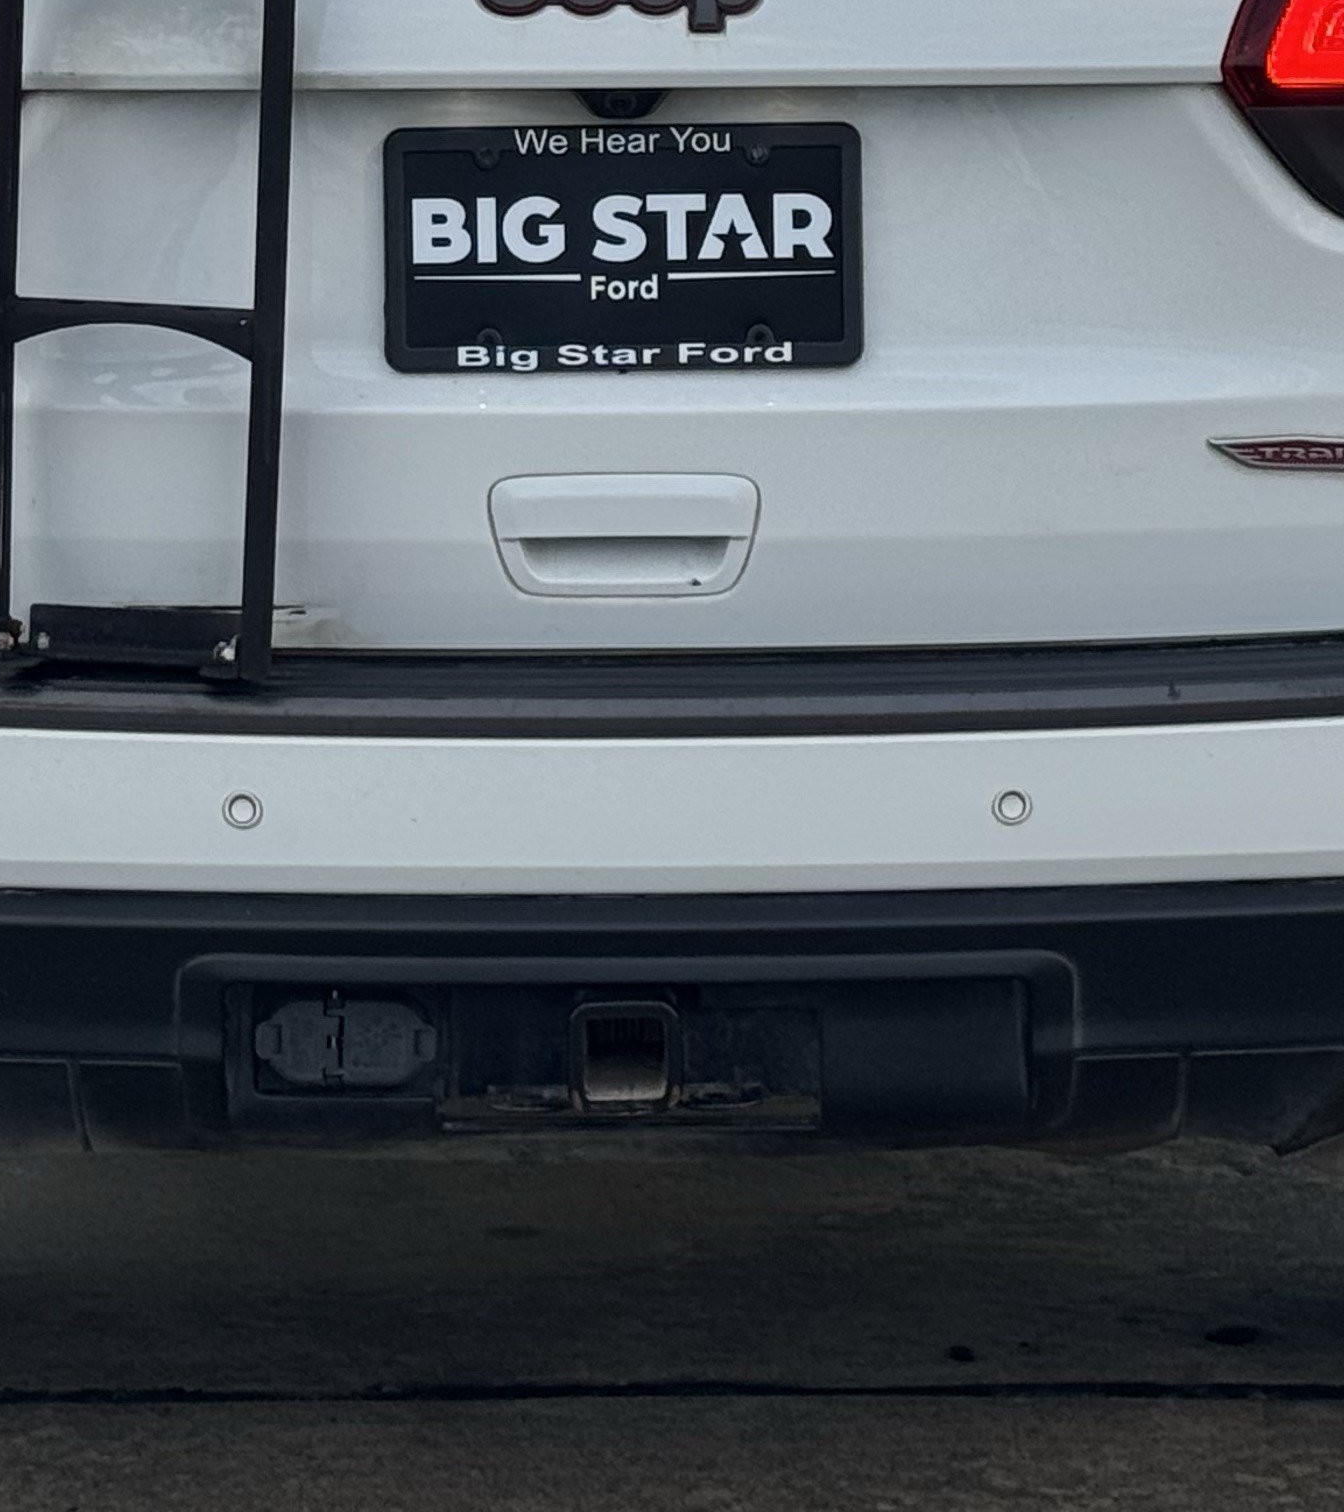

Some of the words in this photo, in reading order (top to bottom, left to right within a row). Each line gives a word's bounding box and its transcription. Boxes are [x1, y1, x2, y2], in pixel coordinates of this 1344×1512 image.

[514, 128, 569, 155] We
[581, 128, 660, 155] Hear
[670, 126, 732, 154] You
[411, 195, 567, 265] BIG
[591, 192, 835, 263] STAR
[590, 273, 659, 301] Ford
[456, 345, 539, 371] Big
[557, 344, 661, 366] Star
[678, 341, 794, 364] Ford
